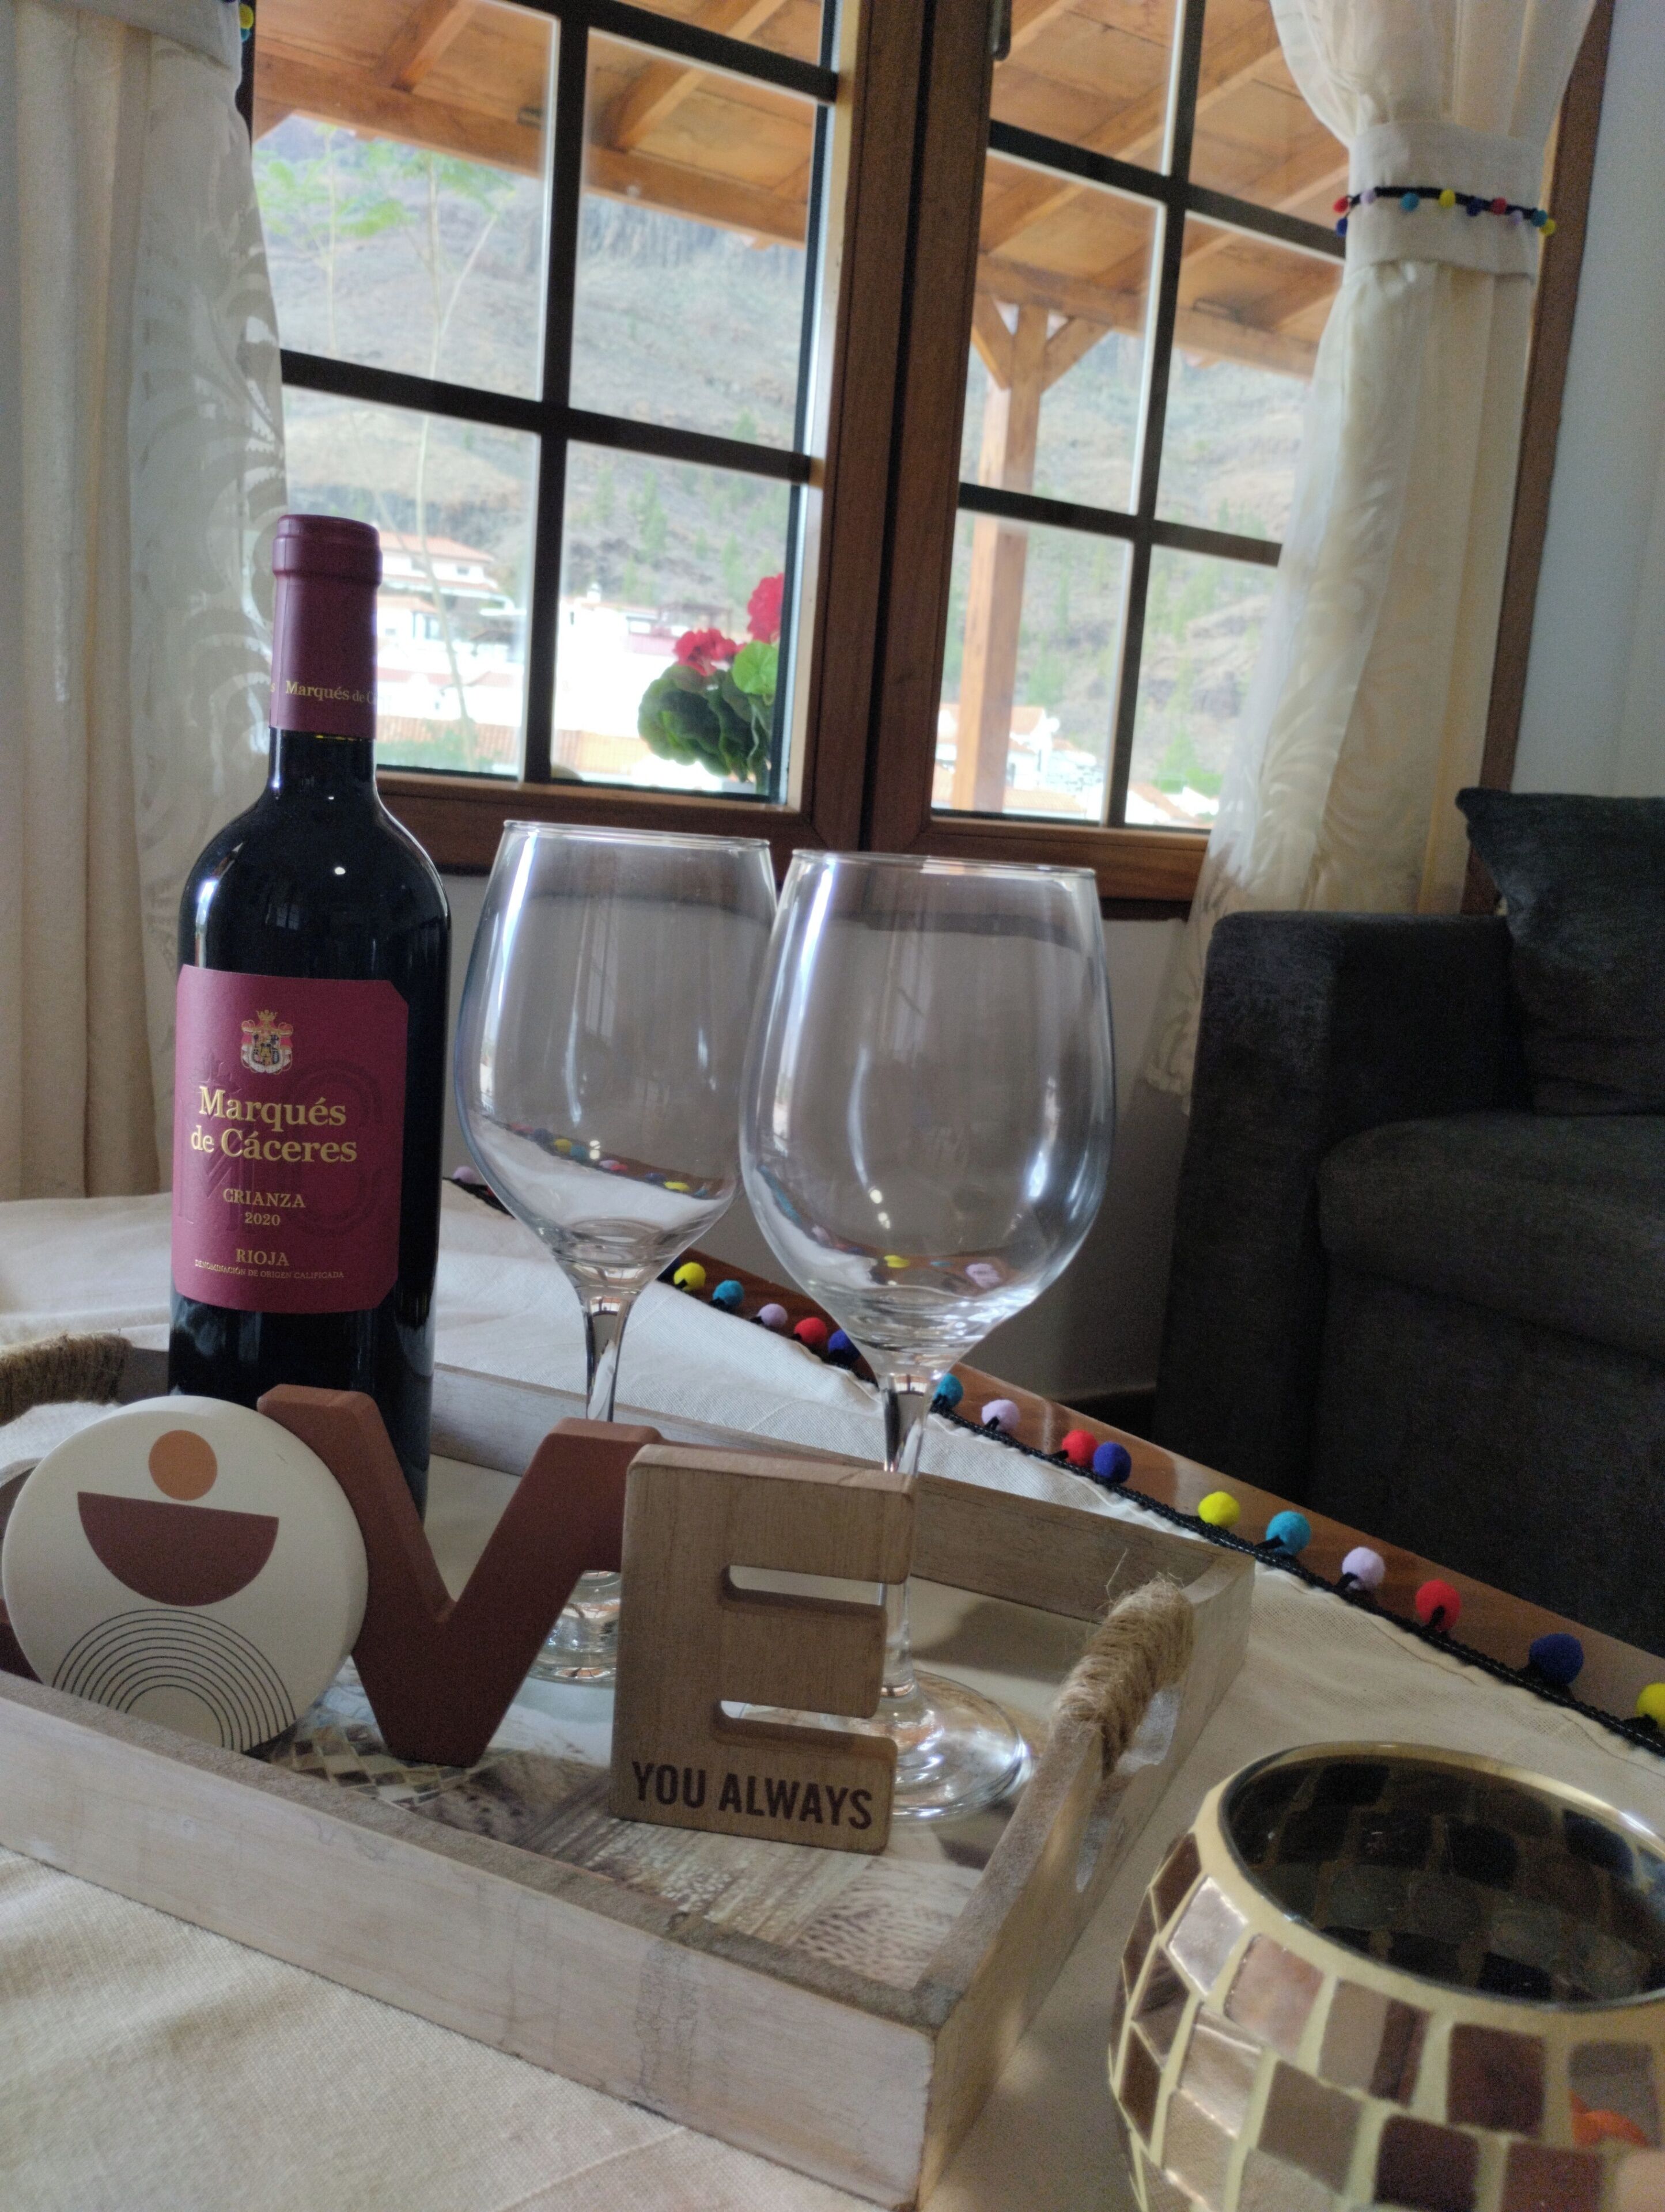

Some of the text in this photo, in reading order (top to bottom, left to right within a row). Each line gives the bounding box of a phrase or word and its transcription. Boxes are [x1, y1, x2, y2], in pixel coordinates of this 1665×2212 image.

[286, 680, 349, 701] Marqués
[352, 691, 364, 702] de
[199, 1086, 346, 1132] Marqués
[191, 1126, 357, 1162] de Cáceres
[224, 1188, 306, 1207] CRIANZA
[245, 1213, 281, 1226] 2020
[236, 1249, 289, 1266] RIOJA
[195, 1259, 344, 1279] DENOMINACIÓN DE ORIGEN CALIFICADA
[632, 1762, 872, 1830] YOU ALWAYS
